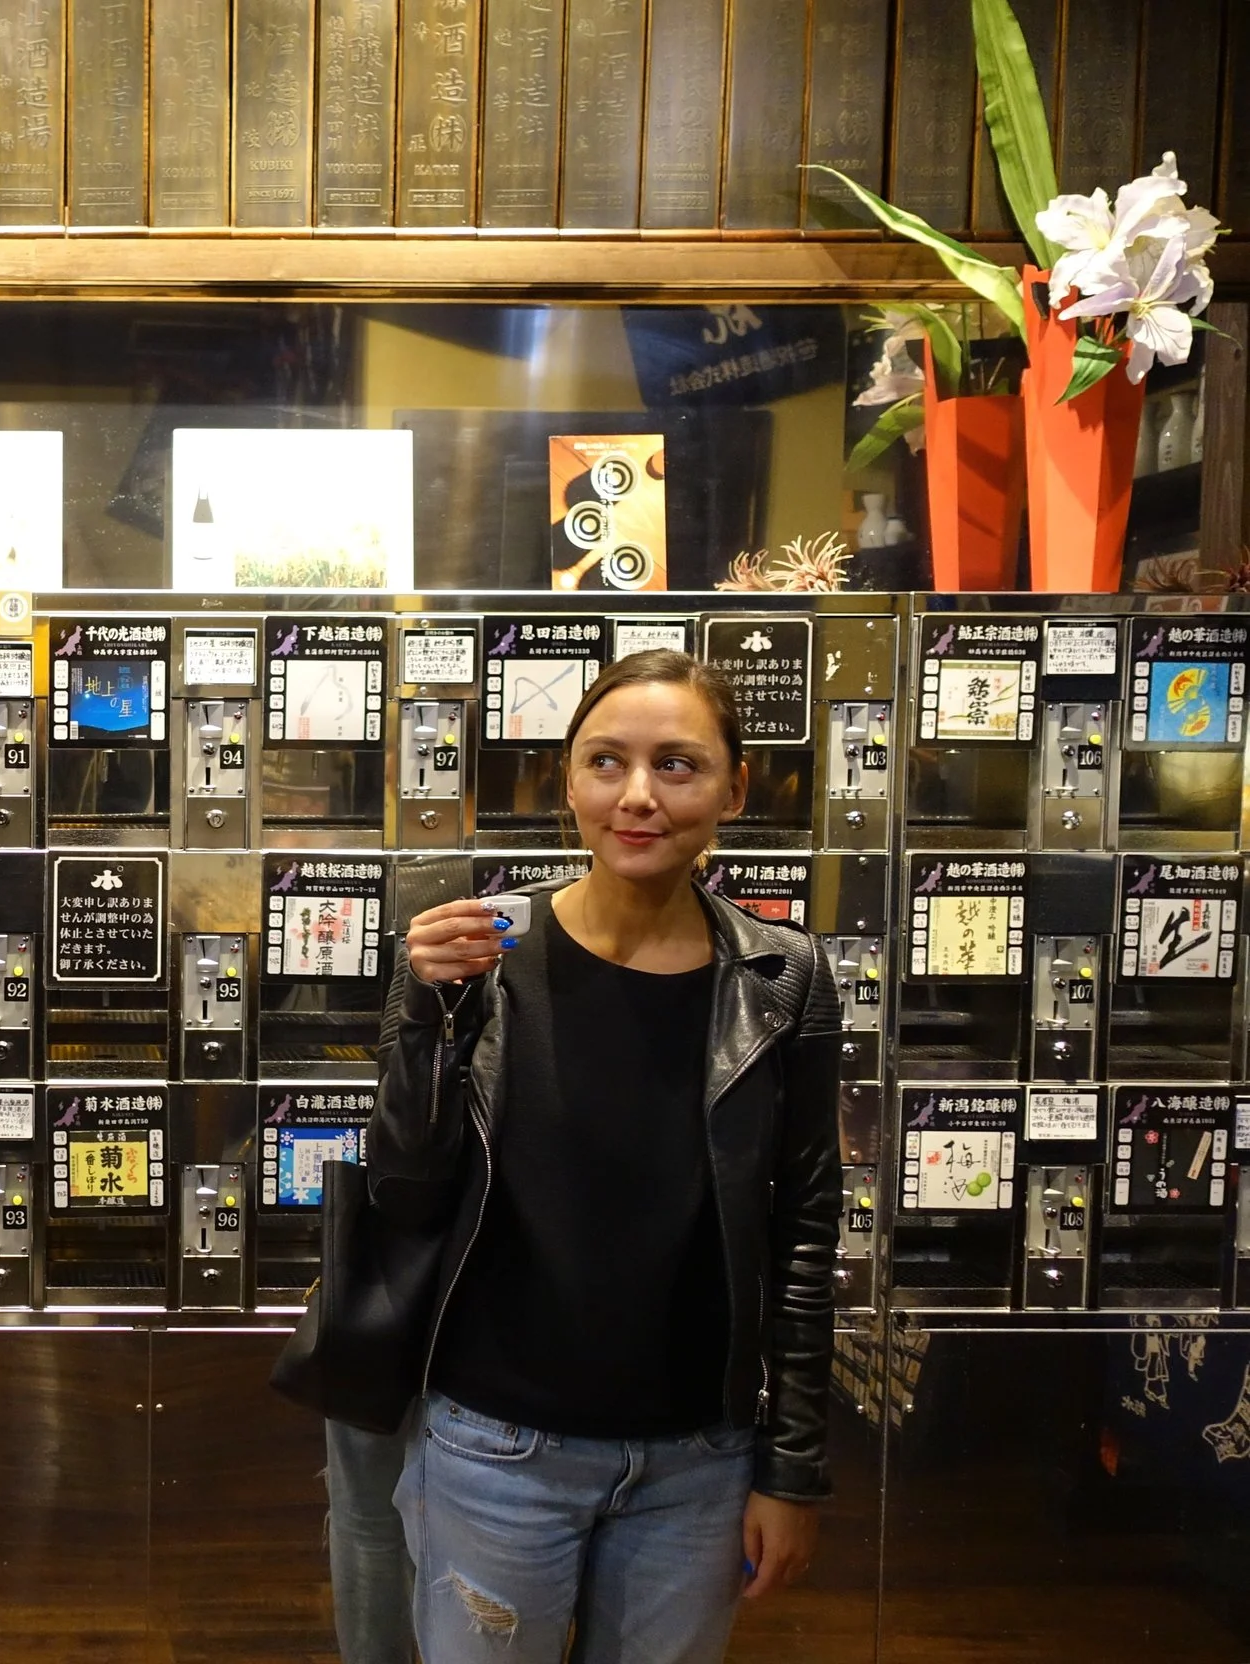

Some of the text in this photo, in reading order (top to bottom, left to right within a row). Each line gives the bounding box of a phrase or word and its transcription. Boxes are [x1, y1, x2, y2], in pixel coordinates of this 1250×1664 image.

[249, 158, 295, 172] KUBIKI
[731, 674, 803, 686] が調整中の為
[734, 690, 802, 701] とさせていた
[740, 723, 796, 733] ください。
[8, 750, 26, 763] 91
[223, 750, 245, 764] 94
[433, 752, 456, 766] 97
[865, 751, 887, 766] 103
[1079, 750, 1101, 766] 106
[61, 897, 152, 908] 大変申し訳ありま
[60, 913, 153, 924] せんが調整中の為
[60, 928, 153, 939] 休止とさせていた
[60, 943, 110, 954] だきます。
[60, 959, 145, 970] 御了承ください。
[8, 983, 26, 997] 92
[220, 984, 238, 997] 95
[858, 986, 878, 1000] 104
[1072, 985, 1094, 999] 107
[100, 1146, 124, 1193] 菊水
[6, 1211, 25, 1225] 93
[218, 1213, 237, 1227] 96
[851, 1213, 874, 1230] 105
[1063, 1212, 1085, 1226] 108
